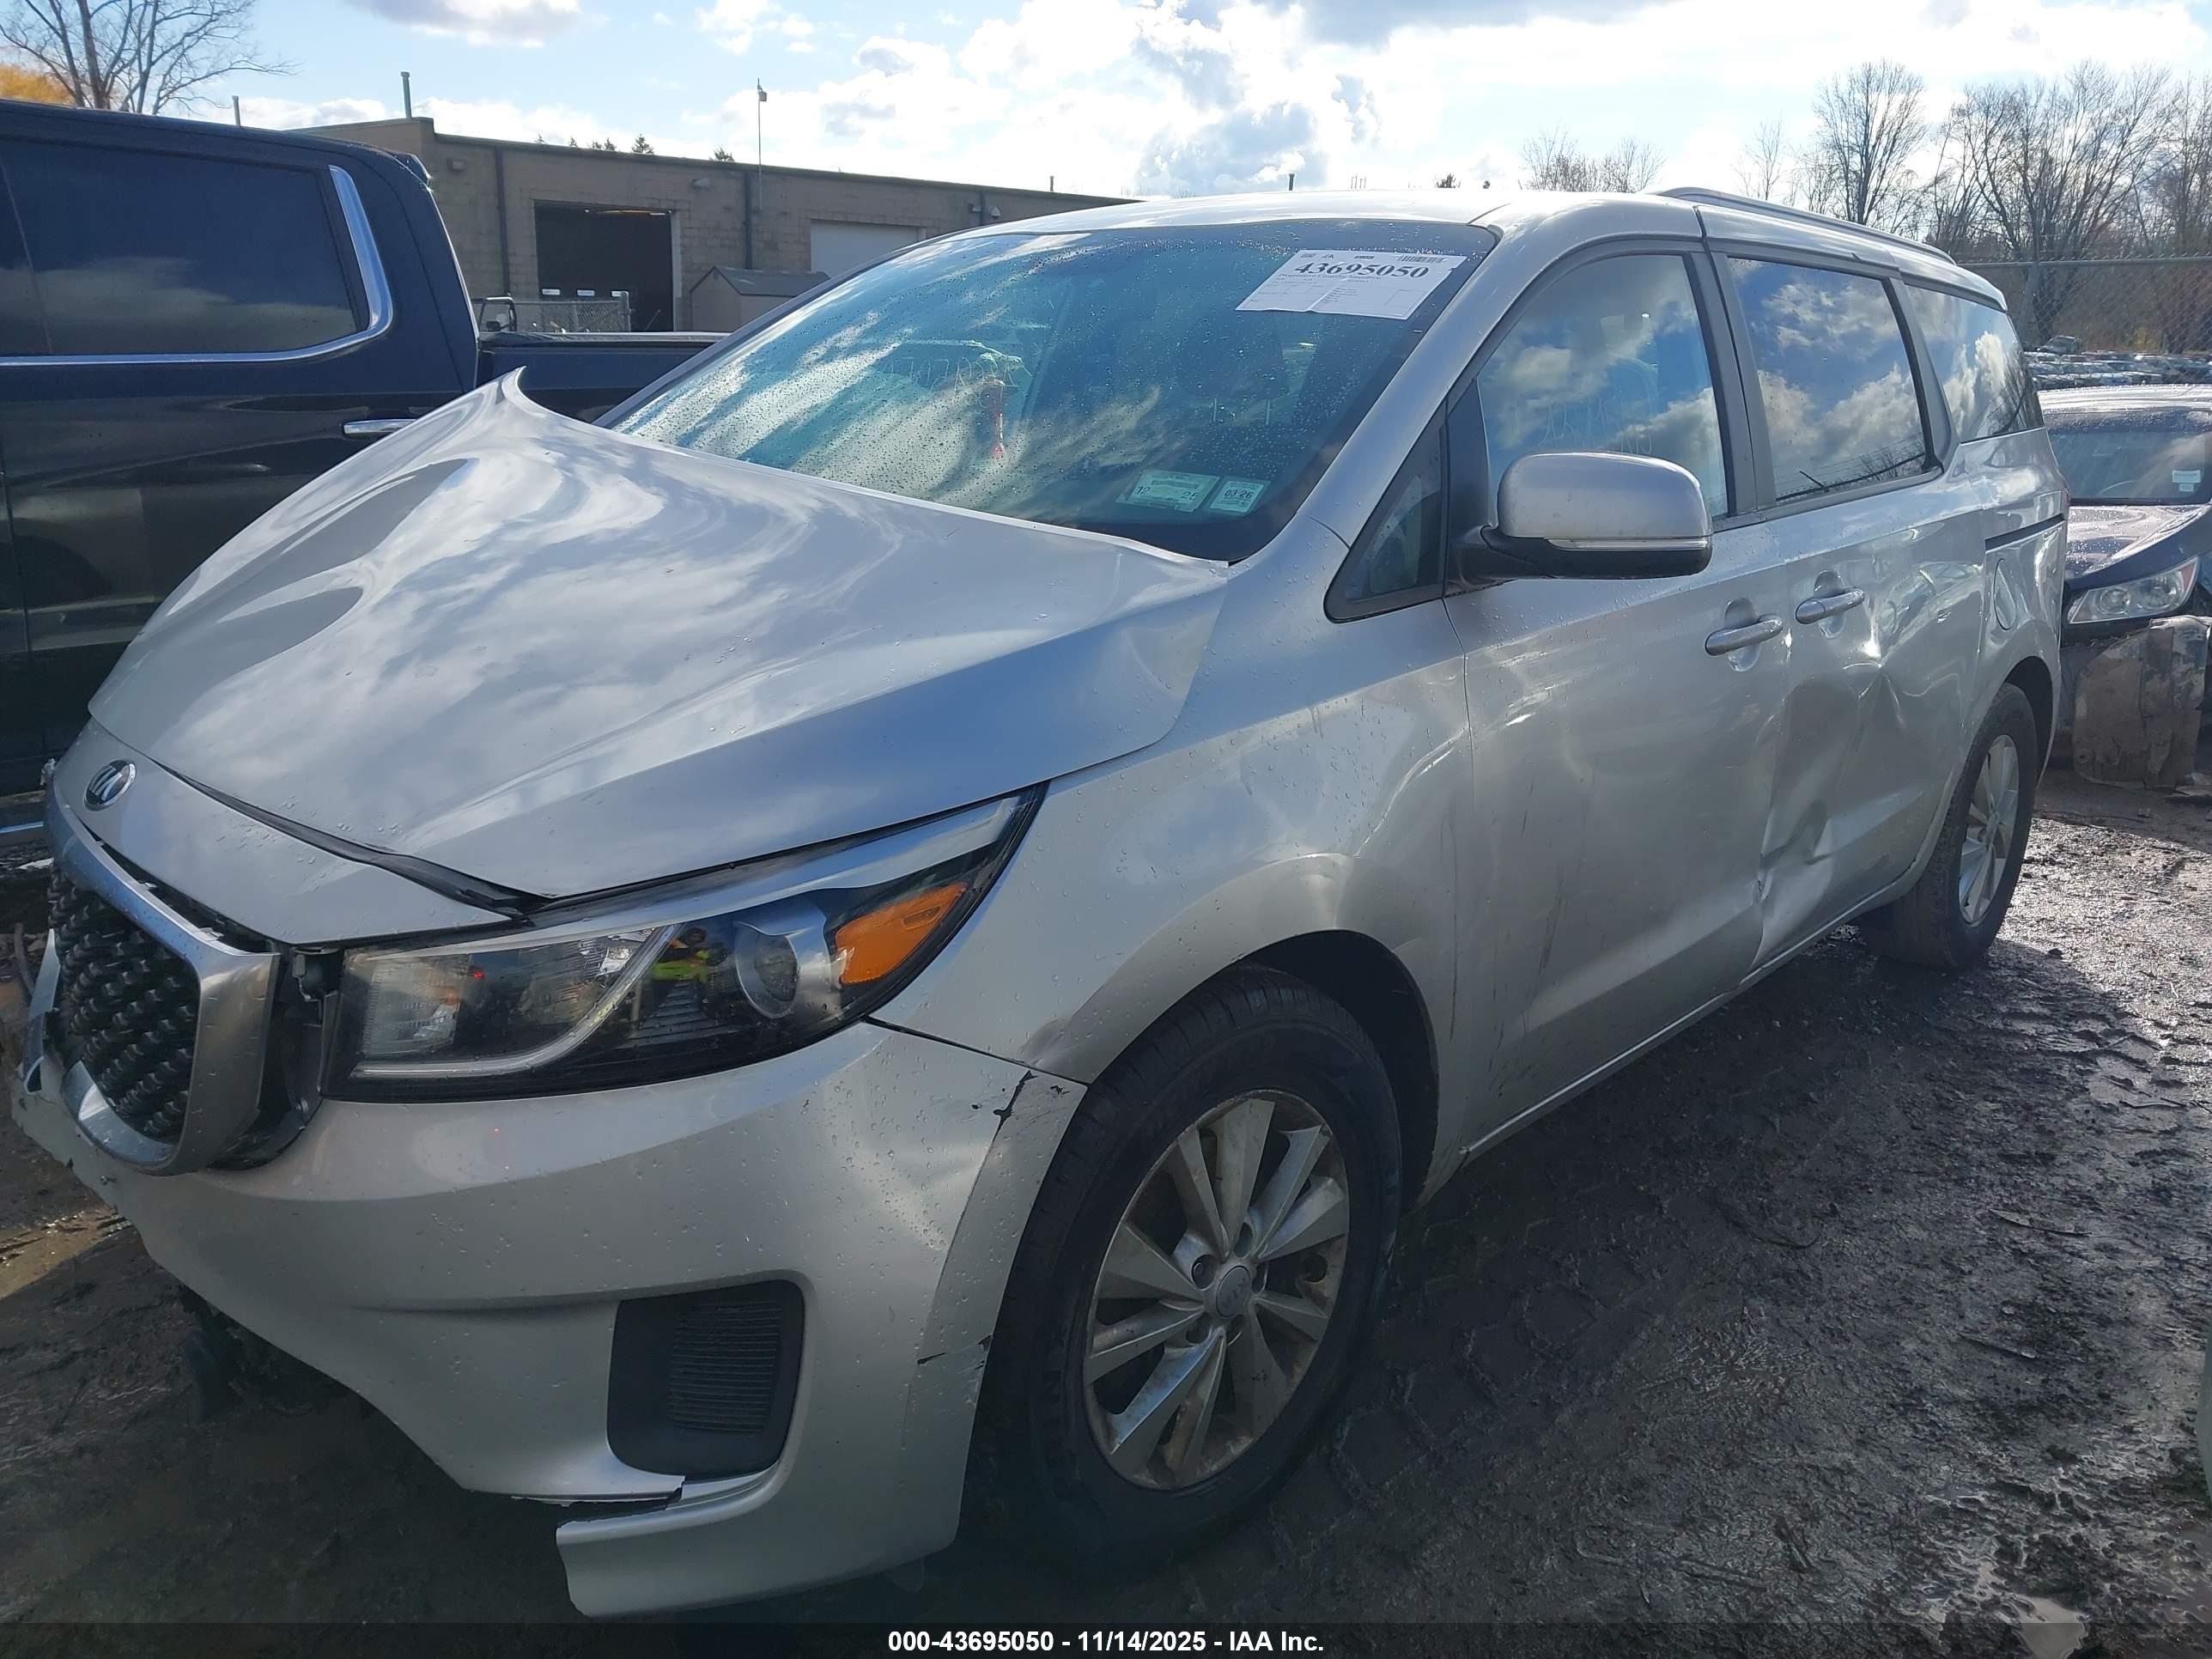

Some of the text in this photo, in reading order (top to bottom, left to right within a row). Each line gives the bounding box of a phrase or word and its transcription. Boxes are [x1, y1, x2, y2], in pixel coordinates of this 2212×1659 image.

[1295, 262, 1430, 278] 43695050
[1136, 486, 1151, 495] 12
[1239, 490, 1254, 499] 26
